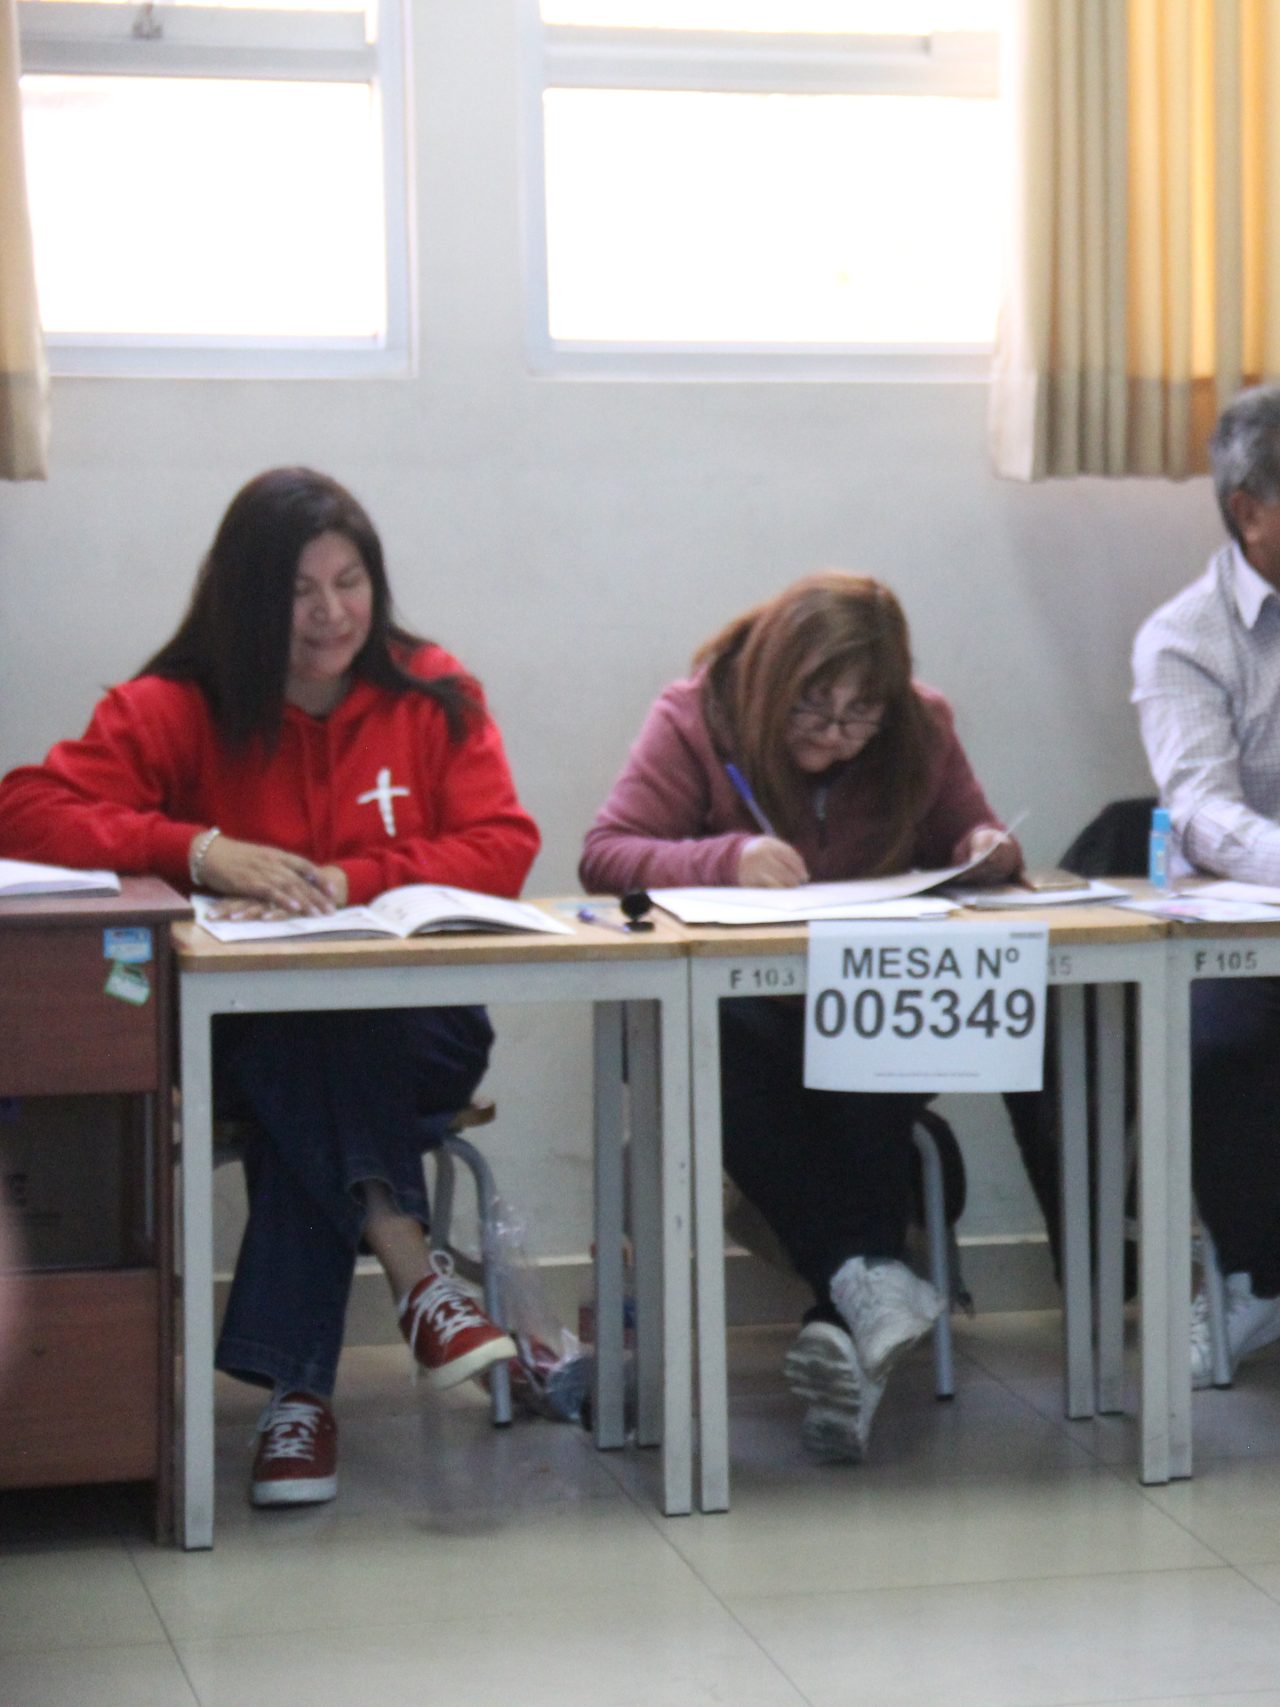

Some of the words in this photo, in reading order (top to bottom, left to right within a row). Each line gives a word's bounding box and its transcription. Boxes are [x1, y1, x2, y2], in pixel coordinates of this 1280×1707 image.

[842, 947, 962, 980] MESA
[1195, 951, 1207, 972] F
[1217, 950, 1258, 972] 105
[730, 969, 742, 990] F
[813, 988, 1036, 1039] 005349
